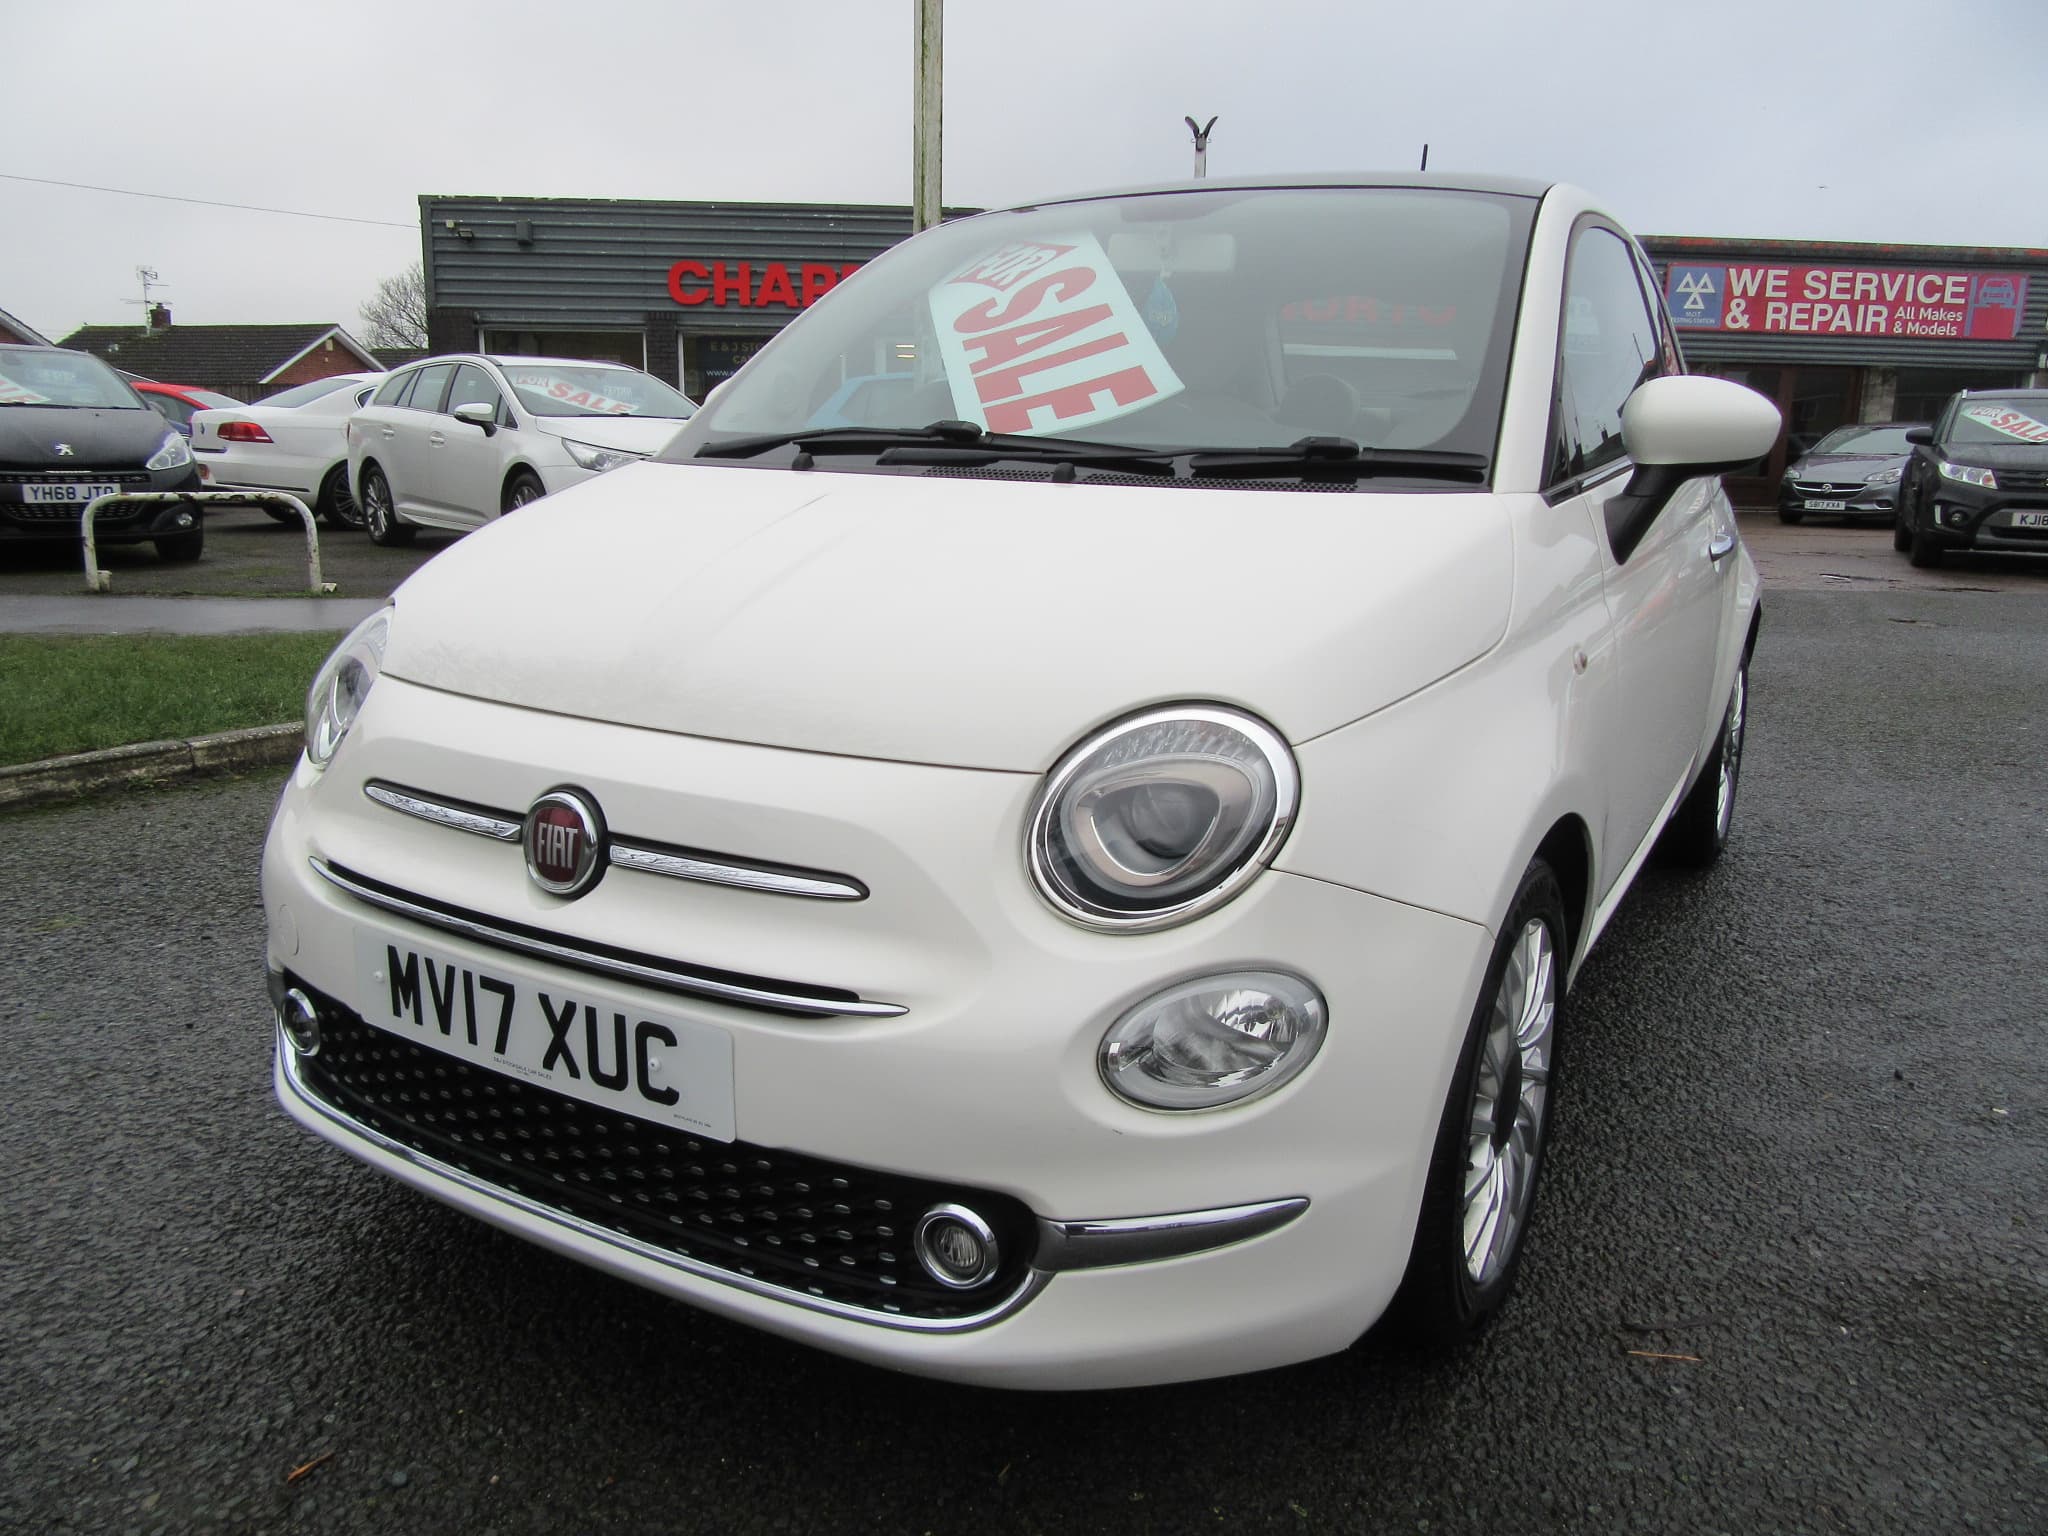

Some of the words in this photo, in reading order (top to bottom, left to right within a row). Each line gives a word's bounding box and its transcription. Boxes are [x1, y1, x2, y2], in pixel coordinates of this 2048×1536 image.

[1728, 267, 1789, 298] WE
[1803, 269, 1969, 304] SERVICE
[1725, 297, 1750, 330] &
[1764, 301, 1888, 333] REPAIR
[1893, 321, 1903, 334] &
[1906, 322, 1958, 336] Models
[1894, 306, 1915, 320] All
[1919, 307, 1963, 322] Makes
[952, 266, 1158, 434] SALE
[548, 382, 636, 413] SALE
[29, 485, 77, 501] YH68
[537, 822, 579, 869] FIAT
[387, 944, 516, 1056] MV17
[537, 991, 680, 1107] XUC
